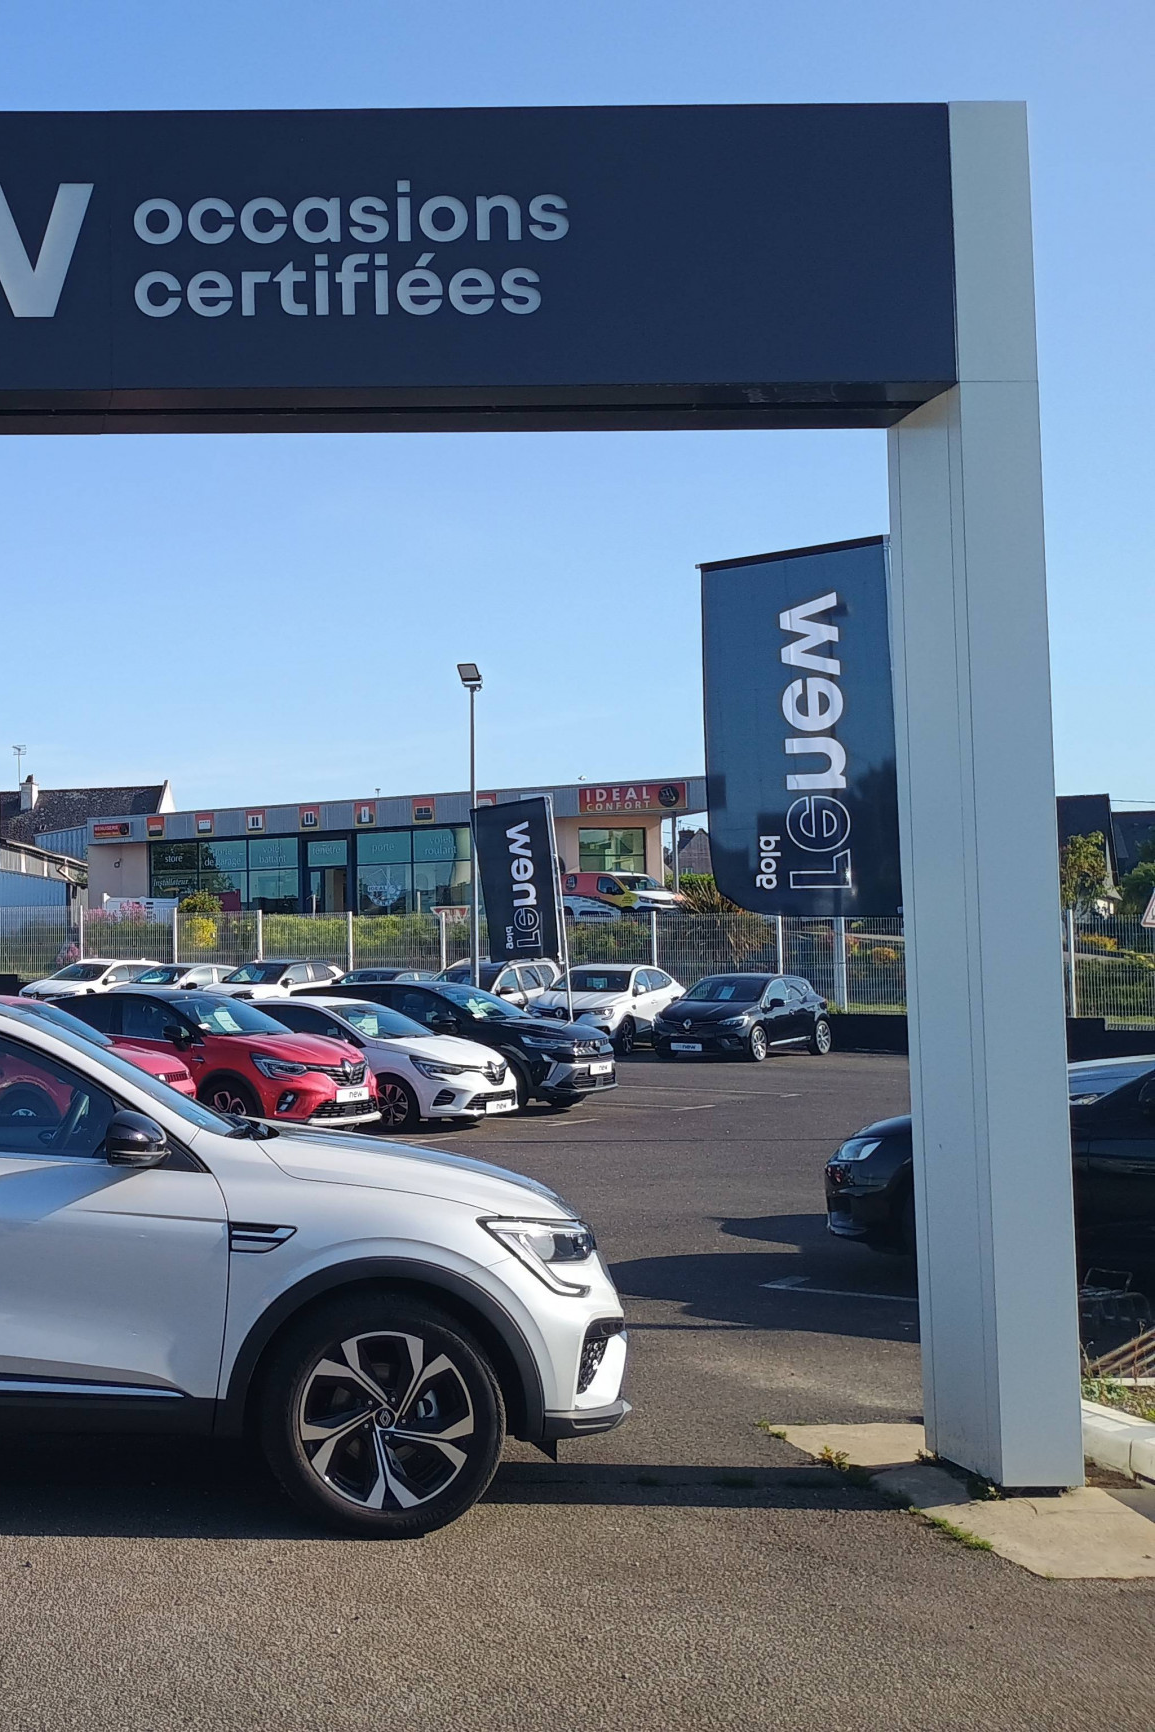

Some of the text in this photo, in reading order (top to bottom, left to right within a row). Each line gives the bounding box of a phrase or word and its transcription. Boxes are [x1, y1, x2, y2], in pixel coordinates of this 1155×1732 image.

[133, 180, 569, 245] occasions
[134, 251, 542, 318] certifiées
[586, 786, 651, 802] IDEAL
[586, 801, 651, 812] CONFORT
[429, 834, 453, 844] volet
[371, 843, 395, 854] porte
[424, 845, 457, 855] roulant
[164, 854, 183, 863] store
[204, 857, 241, 868] de garage
